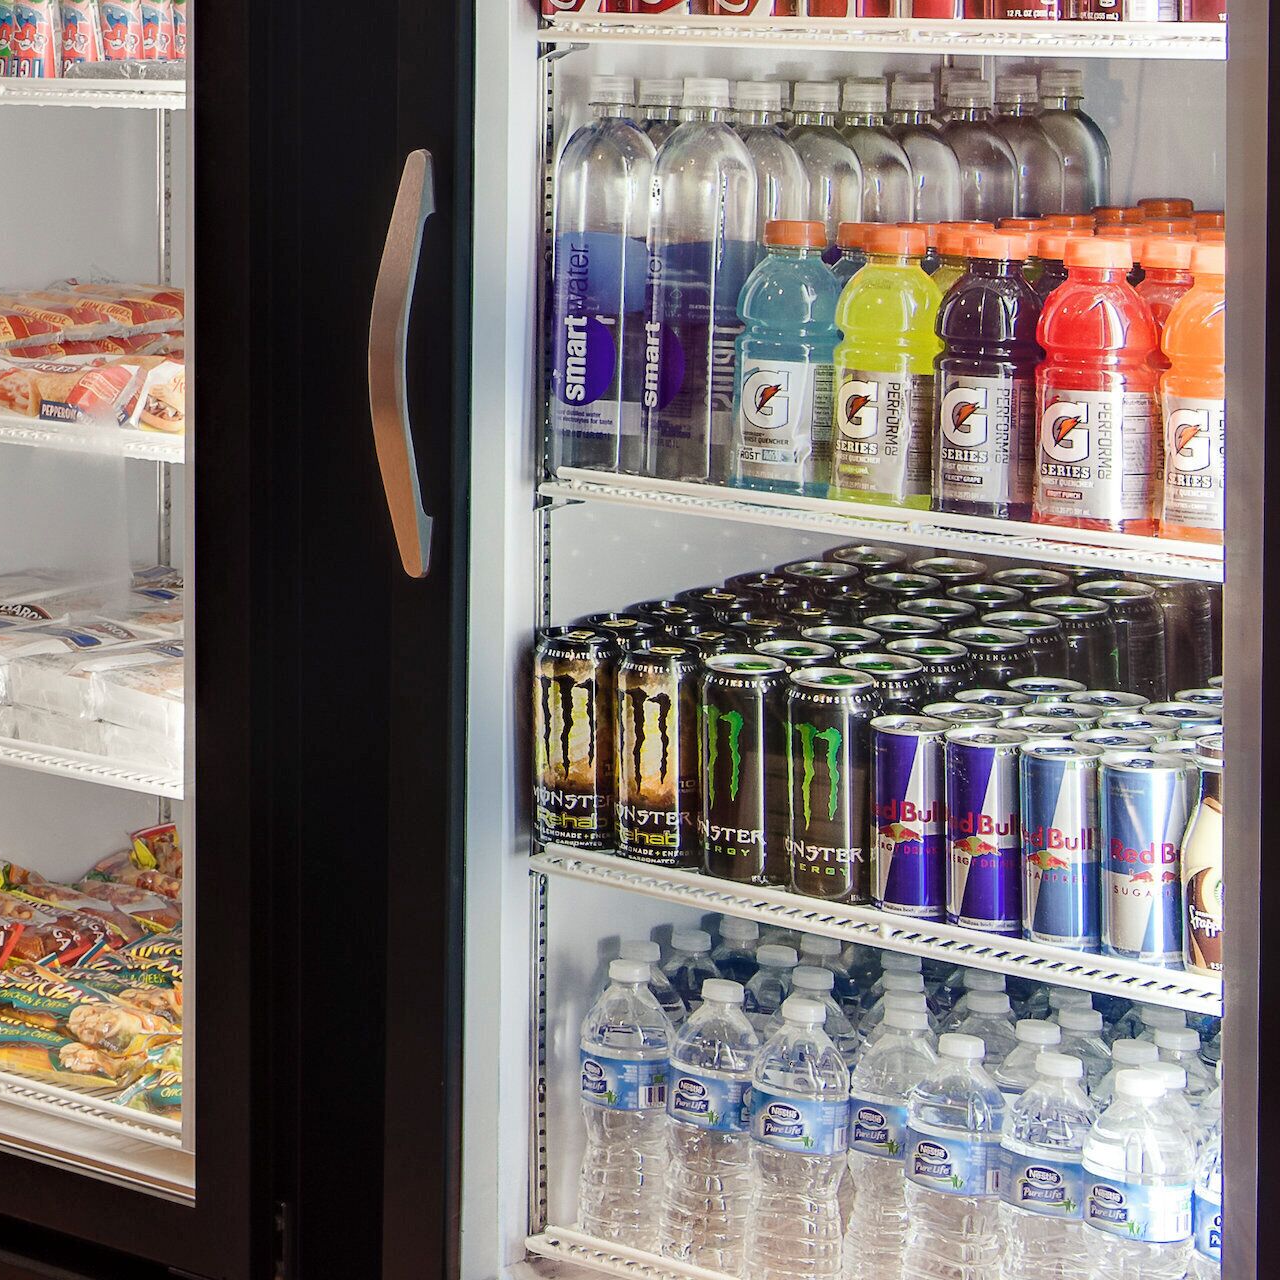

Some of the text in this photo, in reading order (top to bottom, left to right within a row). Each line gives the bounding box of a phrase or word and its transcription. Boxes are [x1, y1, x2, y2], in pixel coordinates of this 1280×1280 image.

[742, 369, 790, 430] G
[836, 379, 880, 440] G
[942, 386, 989, 448] G
[1042, 400, 1090, 463] G
[758, 436, 789, 446] QUENCHER
[836, 439, 879, 455] SERIES
[1169, 408, 1210, 474] G
[941, 447, 989, 464] SERIES
[1041, 463, 1091, 480] SERIES
[537, 805, 608, 830] Rehab
[900, 800, 939, 823] Bull
[542, 827, 582, 840] LEMONADE
[1047, 827, 1093, 851] Bull
[555, 838, 603, 848] CARBONATED
[1110, 837, 1155, 864] Red
[31, 1030, 65, 1043] CHEESE
[675, 1097, 706, 1112] Pure Life
[764, 1122, 802, 1136] Pure Life
[855, 1129, 887, 1142] Pure Life
[915, 1163, 950, 1176] Pure Life
[1023, 1188, 1063, 1200] Pure Life
[1090, 1206, 1127, 1221] Pure Life
